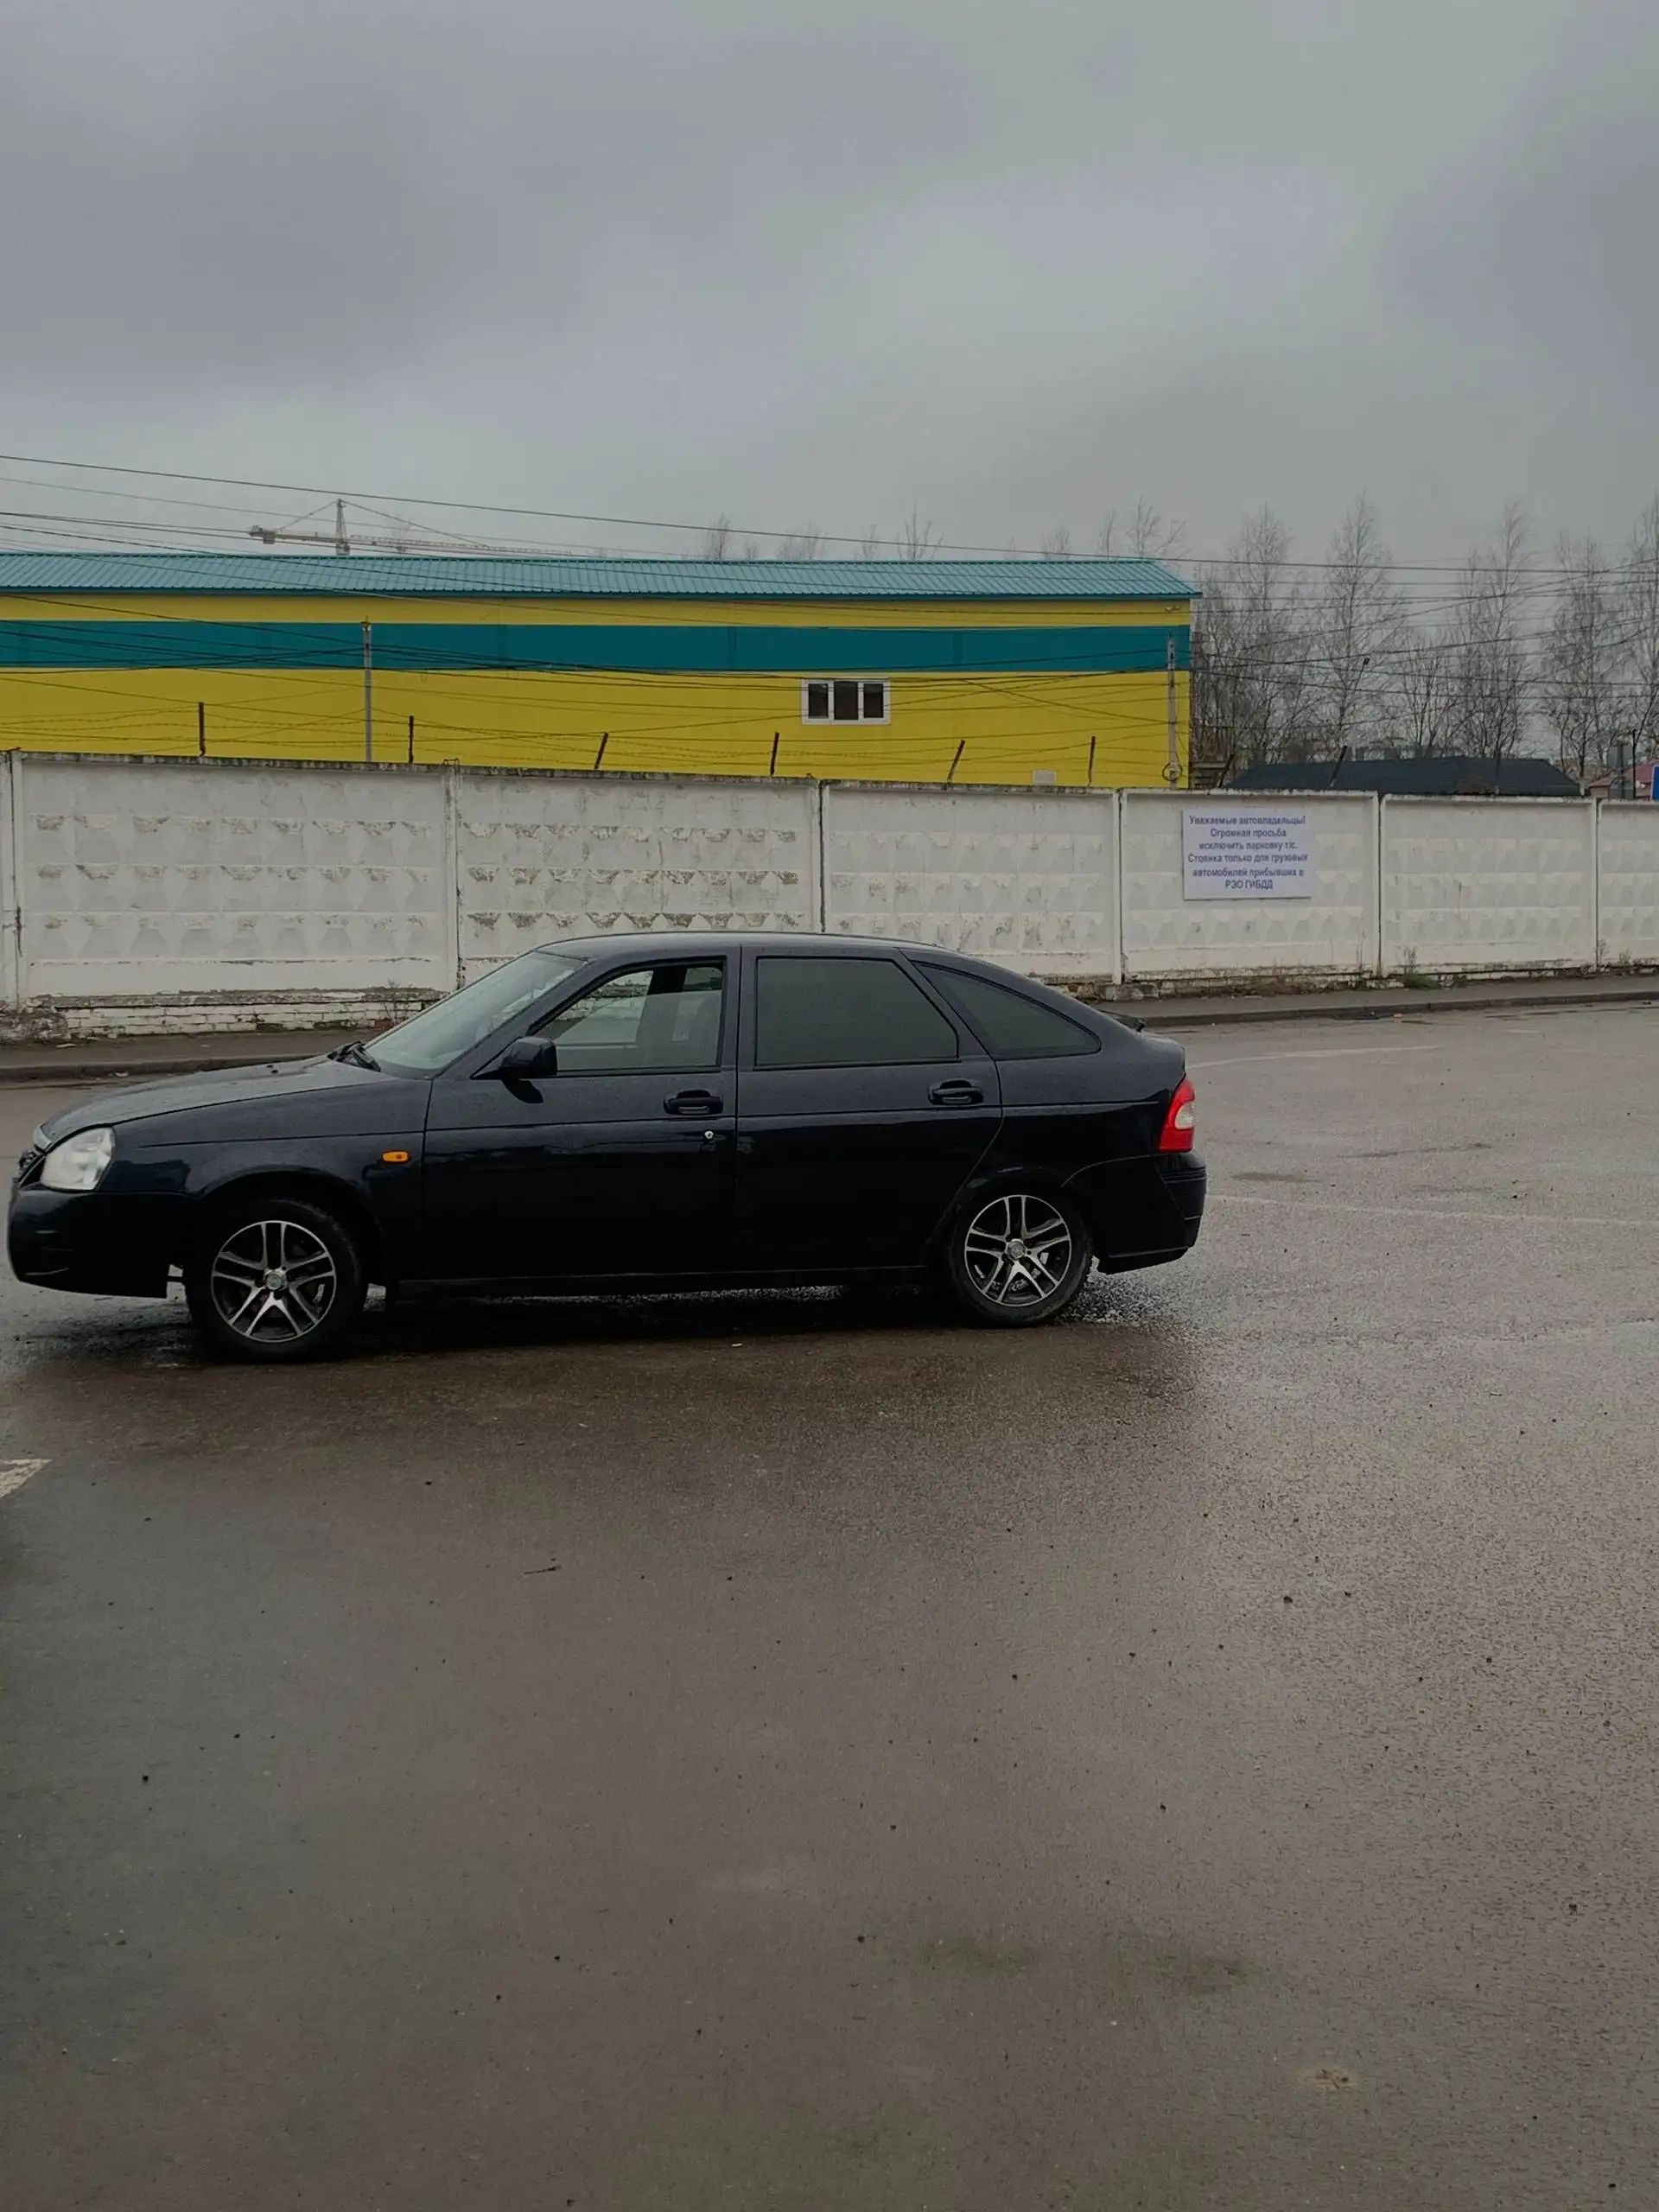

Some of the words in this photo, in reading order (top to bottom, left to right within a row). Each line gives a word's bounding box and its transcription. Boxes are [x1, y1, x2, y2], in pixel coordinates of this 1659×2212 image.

[1189, 816, 1236, 825] Уважаемые
[1211, 829, 1250, 838] Огромная
[1253, 829, 1286, 838] просьба
[1246, 842, 1282, 851] парковку
[1188, 854, 1222, 863] Стоянка
[1271, 854, 1307, 863] грузовых
[1192, 868, 1248, 876] автомобилей
[1249, 868, 1297, 878] прибывших
[1245, 880, 1273, 889] ГИБДД
